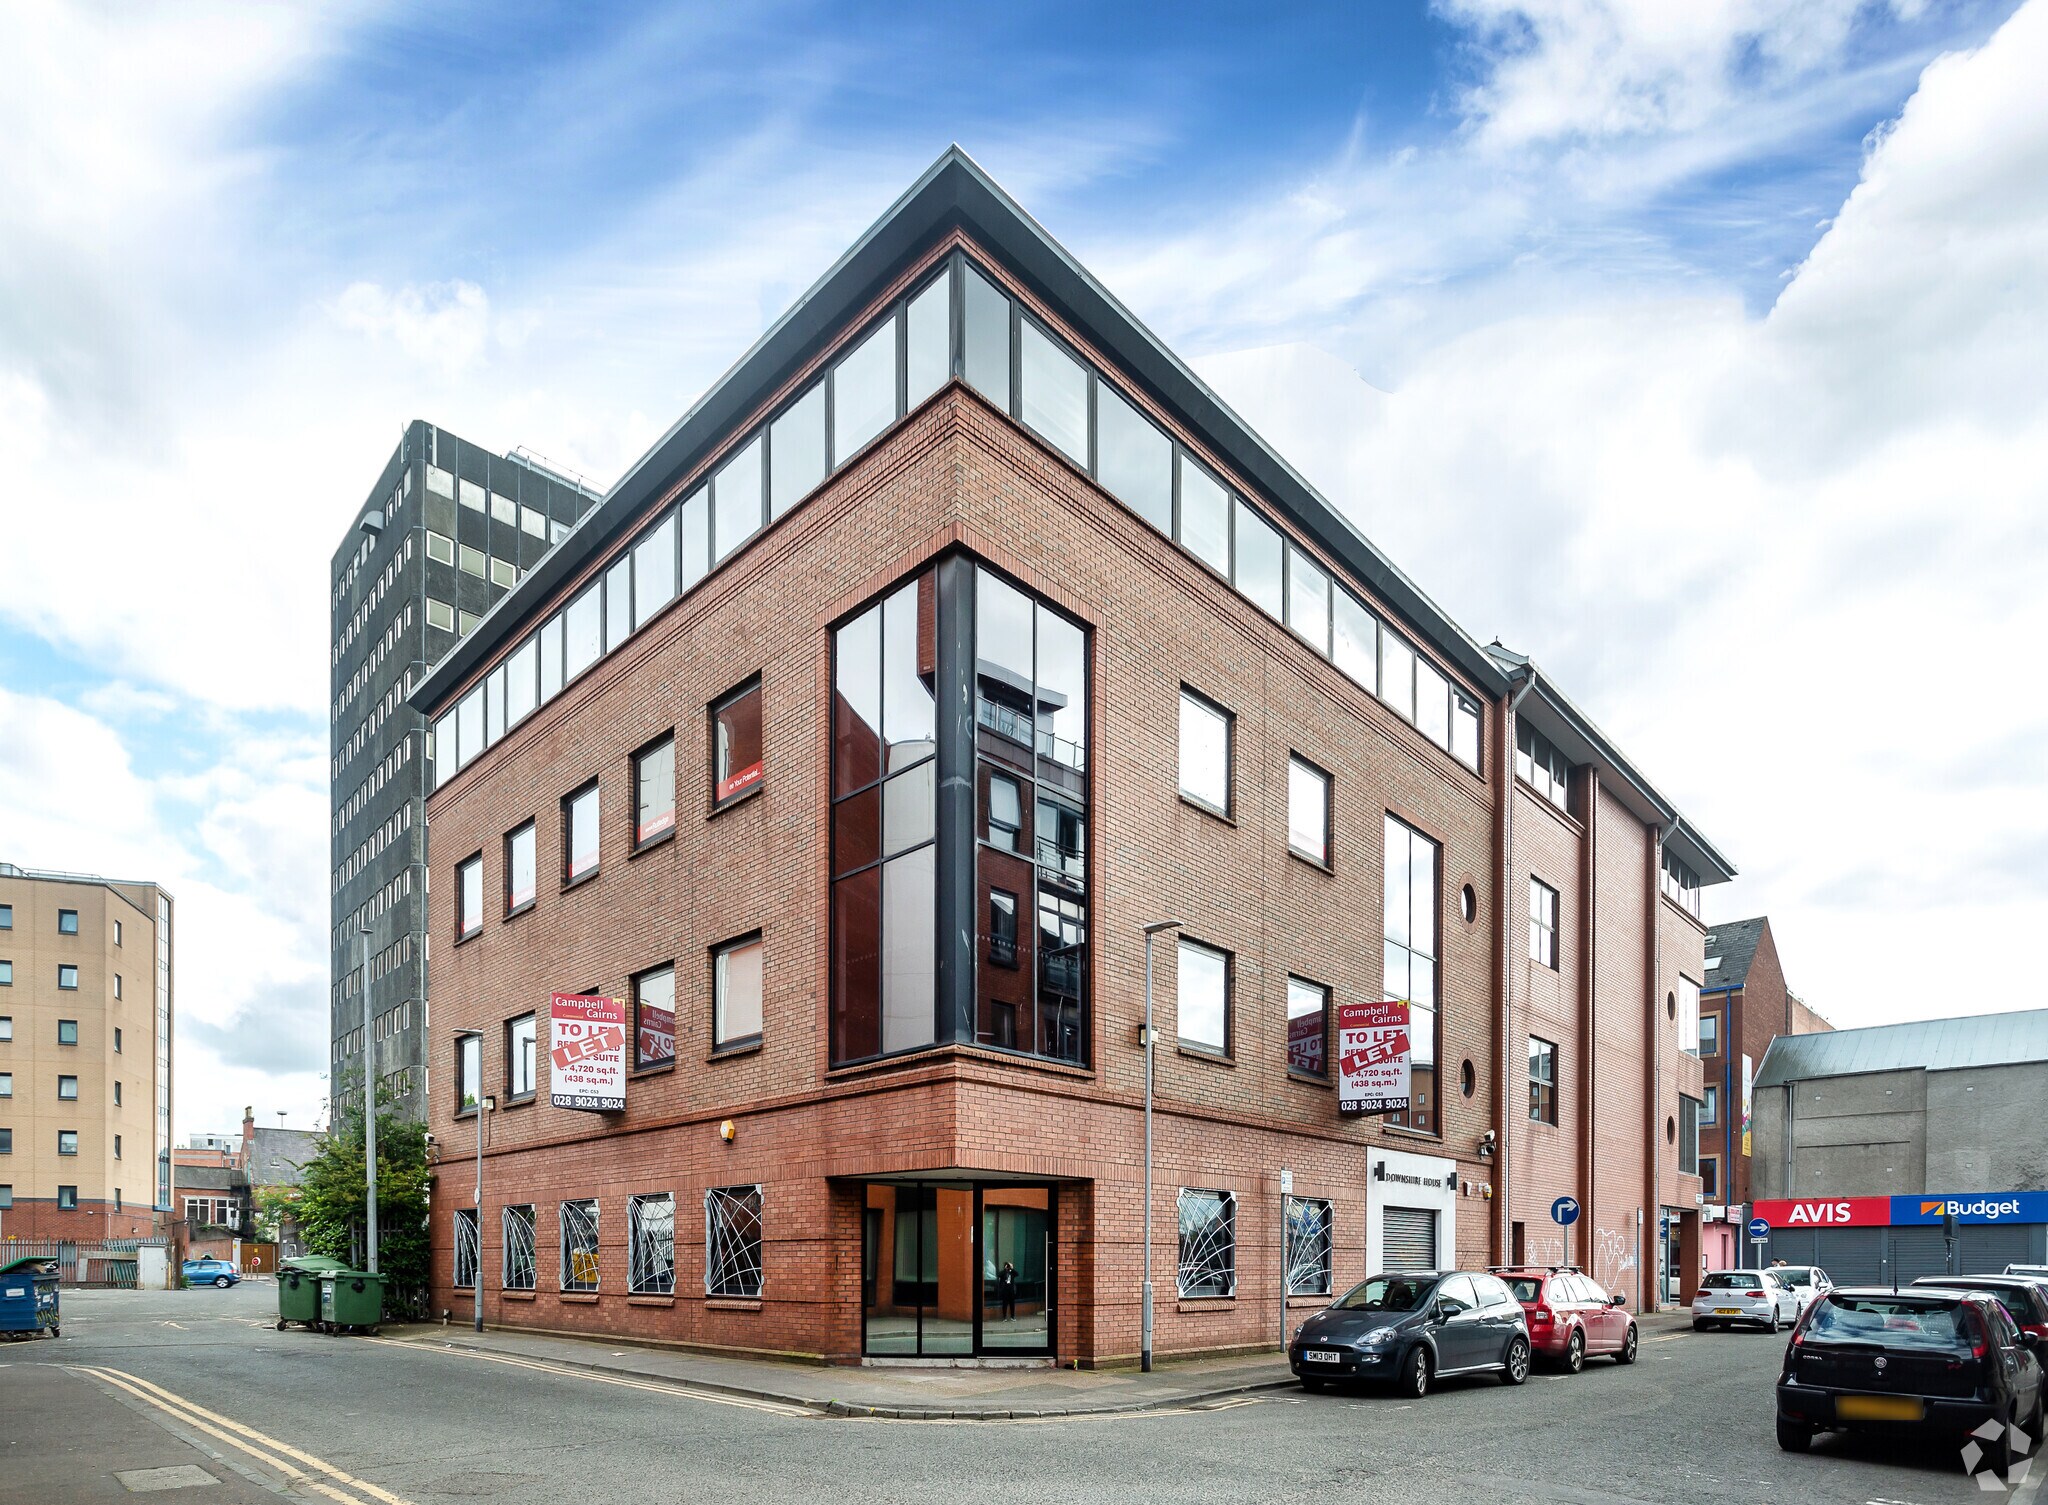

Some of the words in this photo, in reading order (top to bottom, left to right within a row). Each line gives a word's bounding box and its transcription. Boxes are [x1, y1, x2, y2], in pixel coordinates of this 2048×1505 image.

[555, 997, 604, 1009] Campbell
[586, 1009, 618, 1020] Cairns
[1343, 1005, 1389, 1018] Campbell
[1372, 1014, 1402, 1024] Cairns
[558, 1023, 582, 1036] TO
[588, 1025, 617, 1038] LE
[1346, 1032, 1368, 1044] TO
[563, 1032, 609, 1062] LET
[593, 1054, 619, 1062] SUITE
[1352, 1040, 1395, 1068] LET
[570, 1065, 594, 1073] 4,720
[596, 1066, 619, 1075] sq.ft.
[1356, 1069, 1379, 1078] 4,720
[1380, 1068, 1403, 1078] sq.ft.
[586, 1077, 614, 1086] sq.m.)
[1351, 1080, 1369, 1089] (438
[1371, 1079, 1398, 1088] sq.m.)
[553, 1095, 572, 1106] 028
[575, 1096, 598, 1107] 9024
[601, 1098, 624, 1109] 9024
[1341, 1101, 1358, 1111] 028
[1360, 1100, 1383, 1110] 9024
[1385, 1098, 1408, 1109] 9024
[1385, 1173, 1421, 1186] DOWNSHIRE
[1423, 1177, 1442, 1188] HOUSE
[1788, 1202, 1852, 1223] AVIS
[1946, 1199, 2020, 1219] Budget
[1308, 1351, 1323, 1361] SM13
